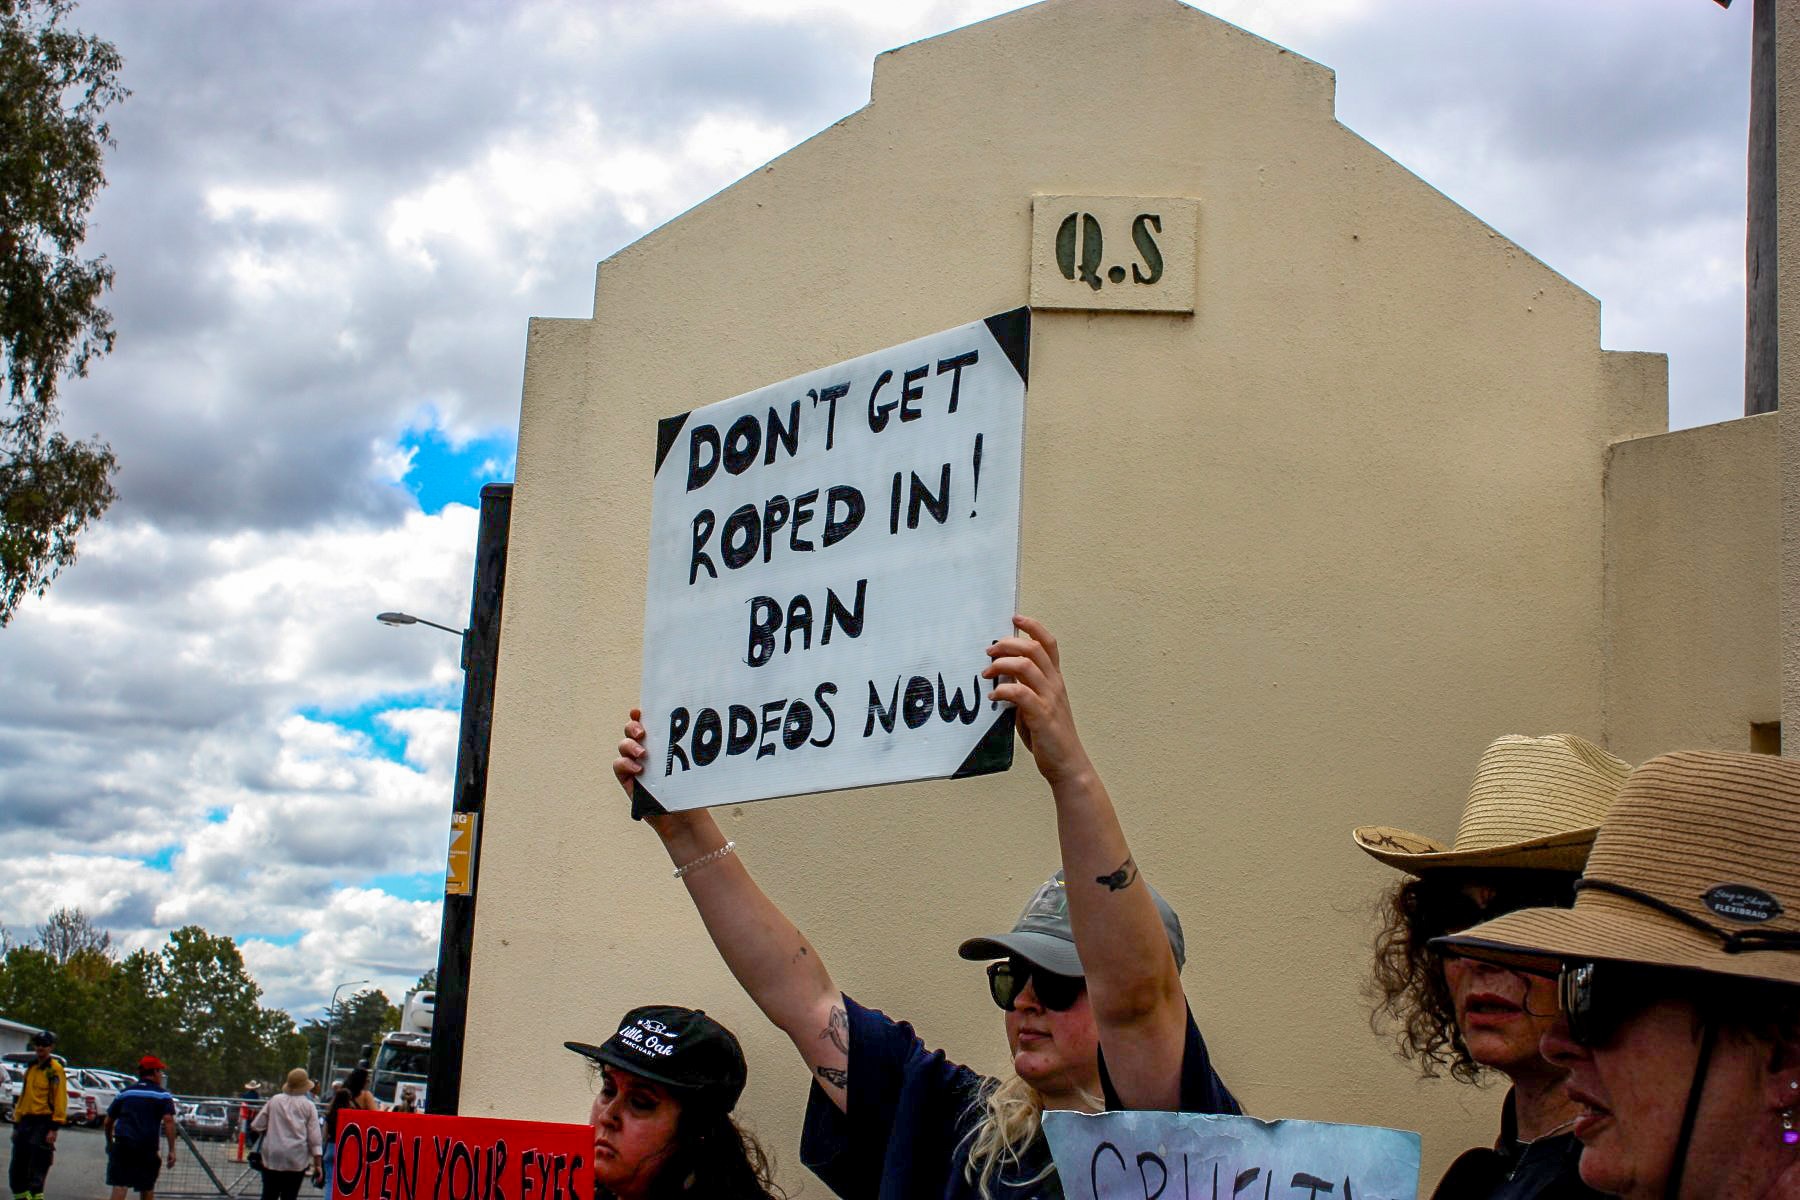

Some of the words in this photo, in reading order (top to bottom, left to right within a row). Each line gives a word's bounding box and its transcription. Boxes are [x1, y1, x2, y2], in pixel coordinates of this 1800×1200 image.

[686, 381, 850, 494] DON'T
[867, 350, 979, 434] GET
[689, 485, 866, 585] ROPED
[742, 579, 867, 668] BAN
[664, 682, 838, 776] RODEOS
[619, 1025, 643, 1042] Little
[645, 1035, 674, 1056] Oak
[621, 1038, 656, 1058] SANCTUARY
[336, 1122, 422, 1200] OPEN
[433, 1135, 508, 1200] YOUR
